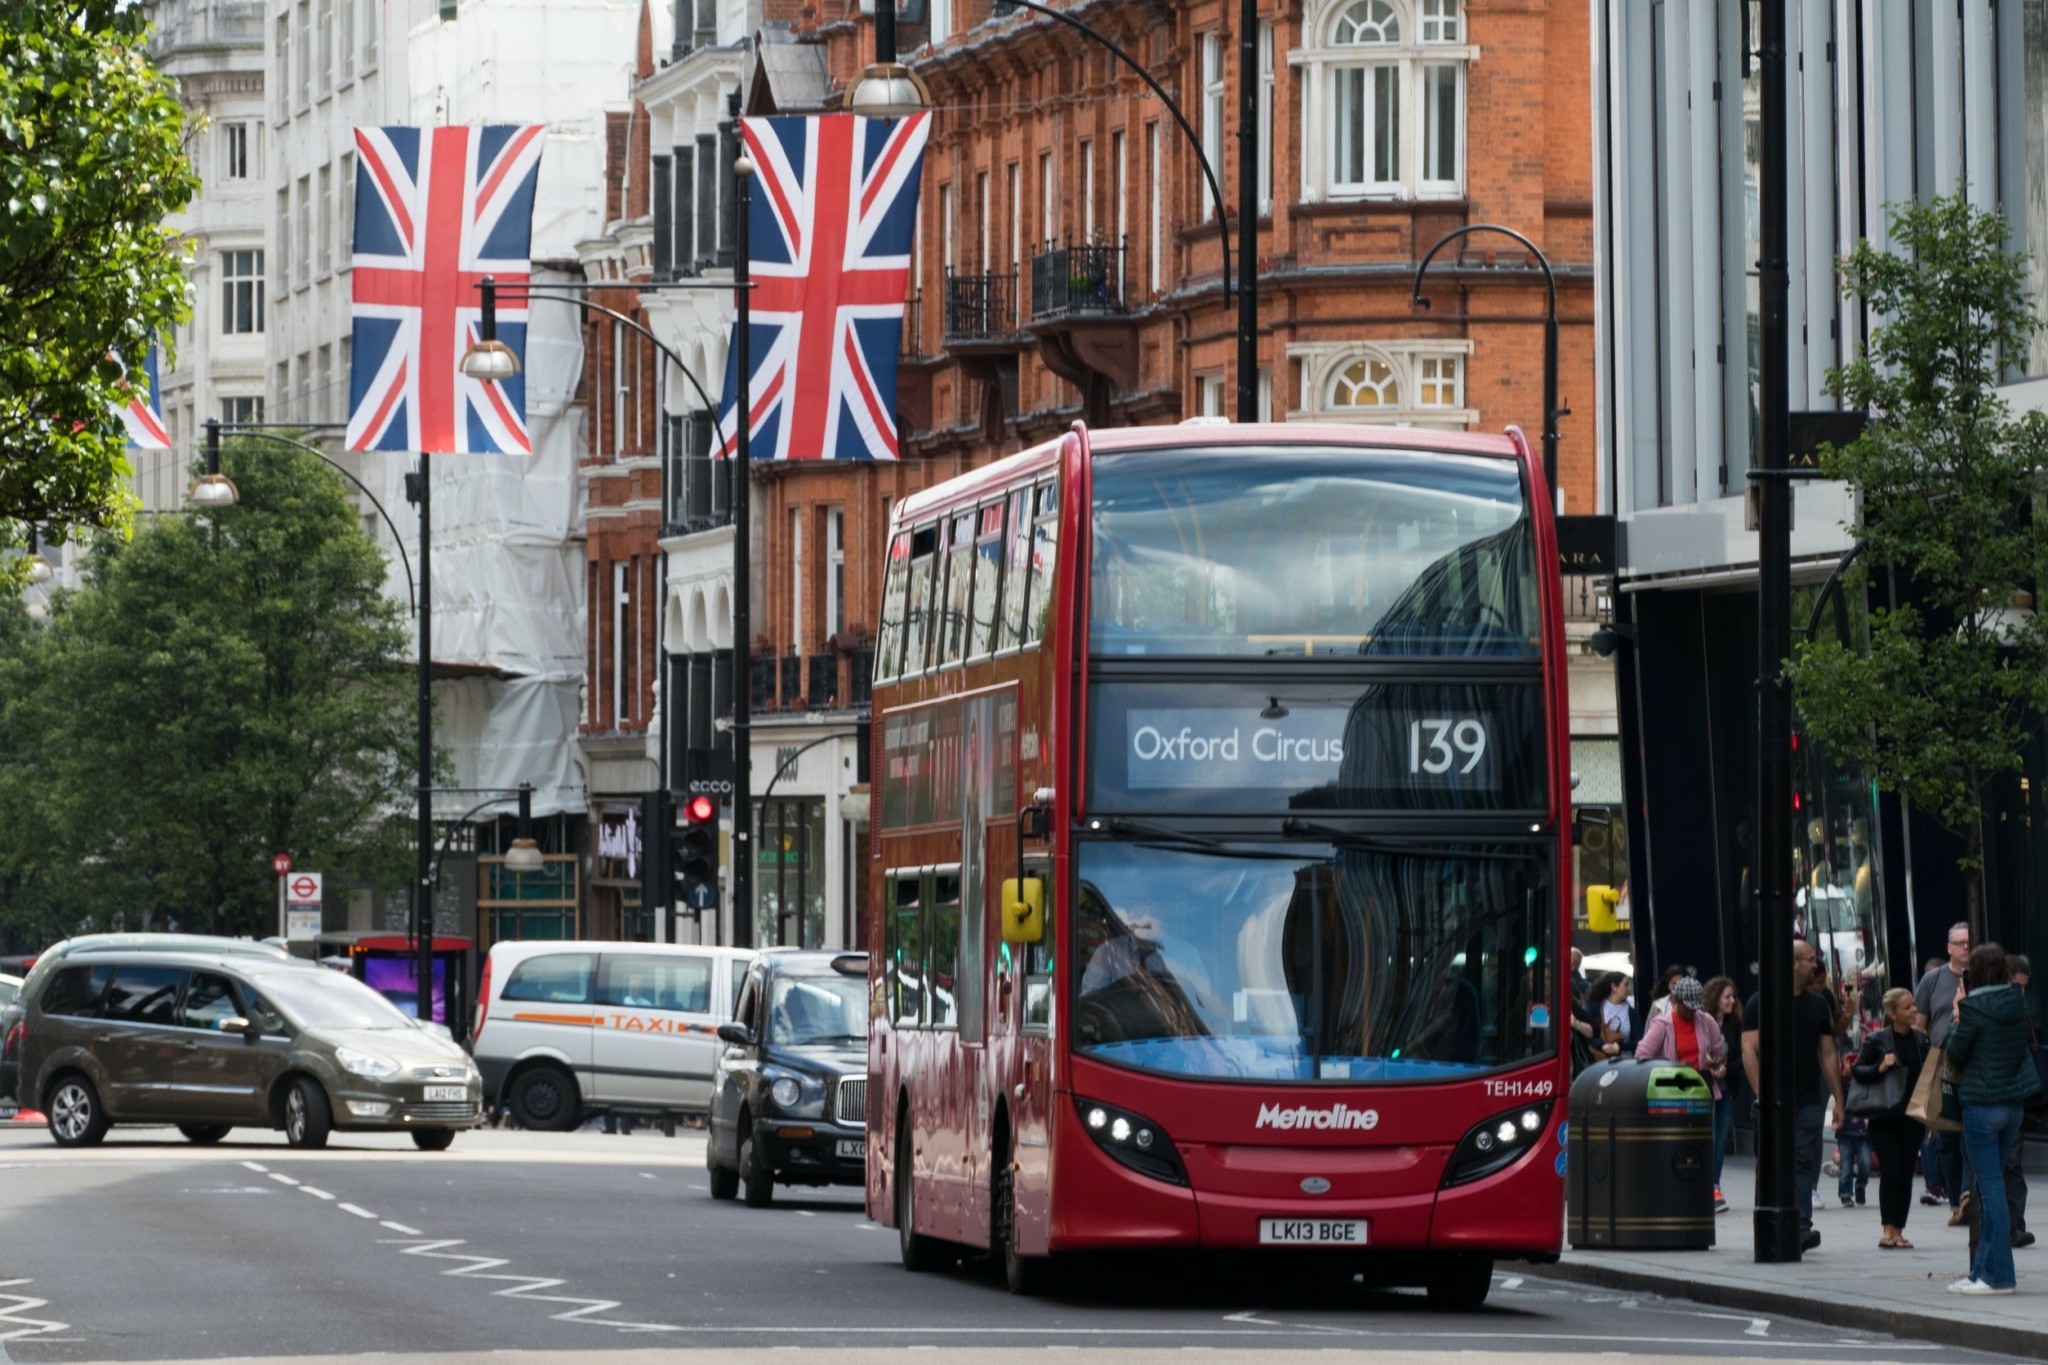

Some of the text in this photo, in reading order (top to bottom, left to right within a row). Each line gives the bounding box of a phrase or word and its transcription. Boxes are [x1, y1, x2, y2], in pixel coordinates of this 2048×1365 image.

[1559, 552, 1602, 564] ARA
[1133, 726, 1345, 763] Oxford Circus
[1410, 718, 1487, 775] 139
[689, 779, 731, 793] ecco
[275, 859, 289, 870] BY
[611, 1013, 673, 1034] TAXI
[1484, 1080, 1553, 1097] TEH1449
[1255, 1102, 1379, 1131] Metroline
[1270, 1219, 1356, 1242] LK13 BGE
